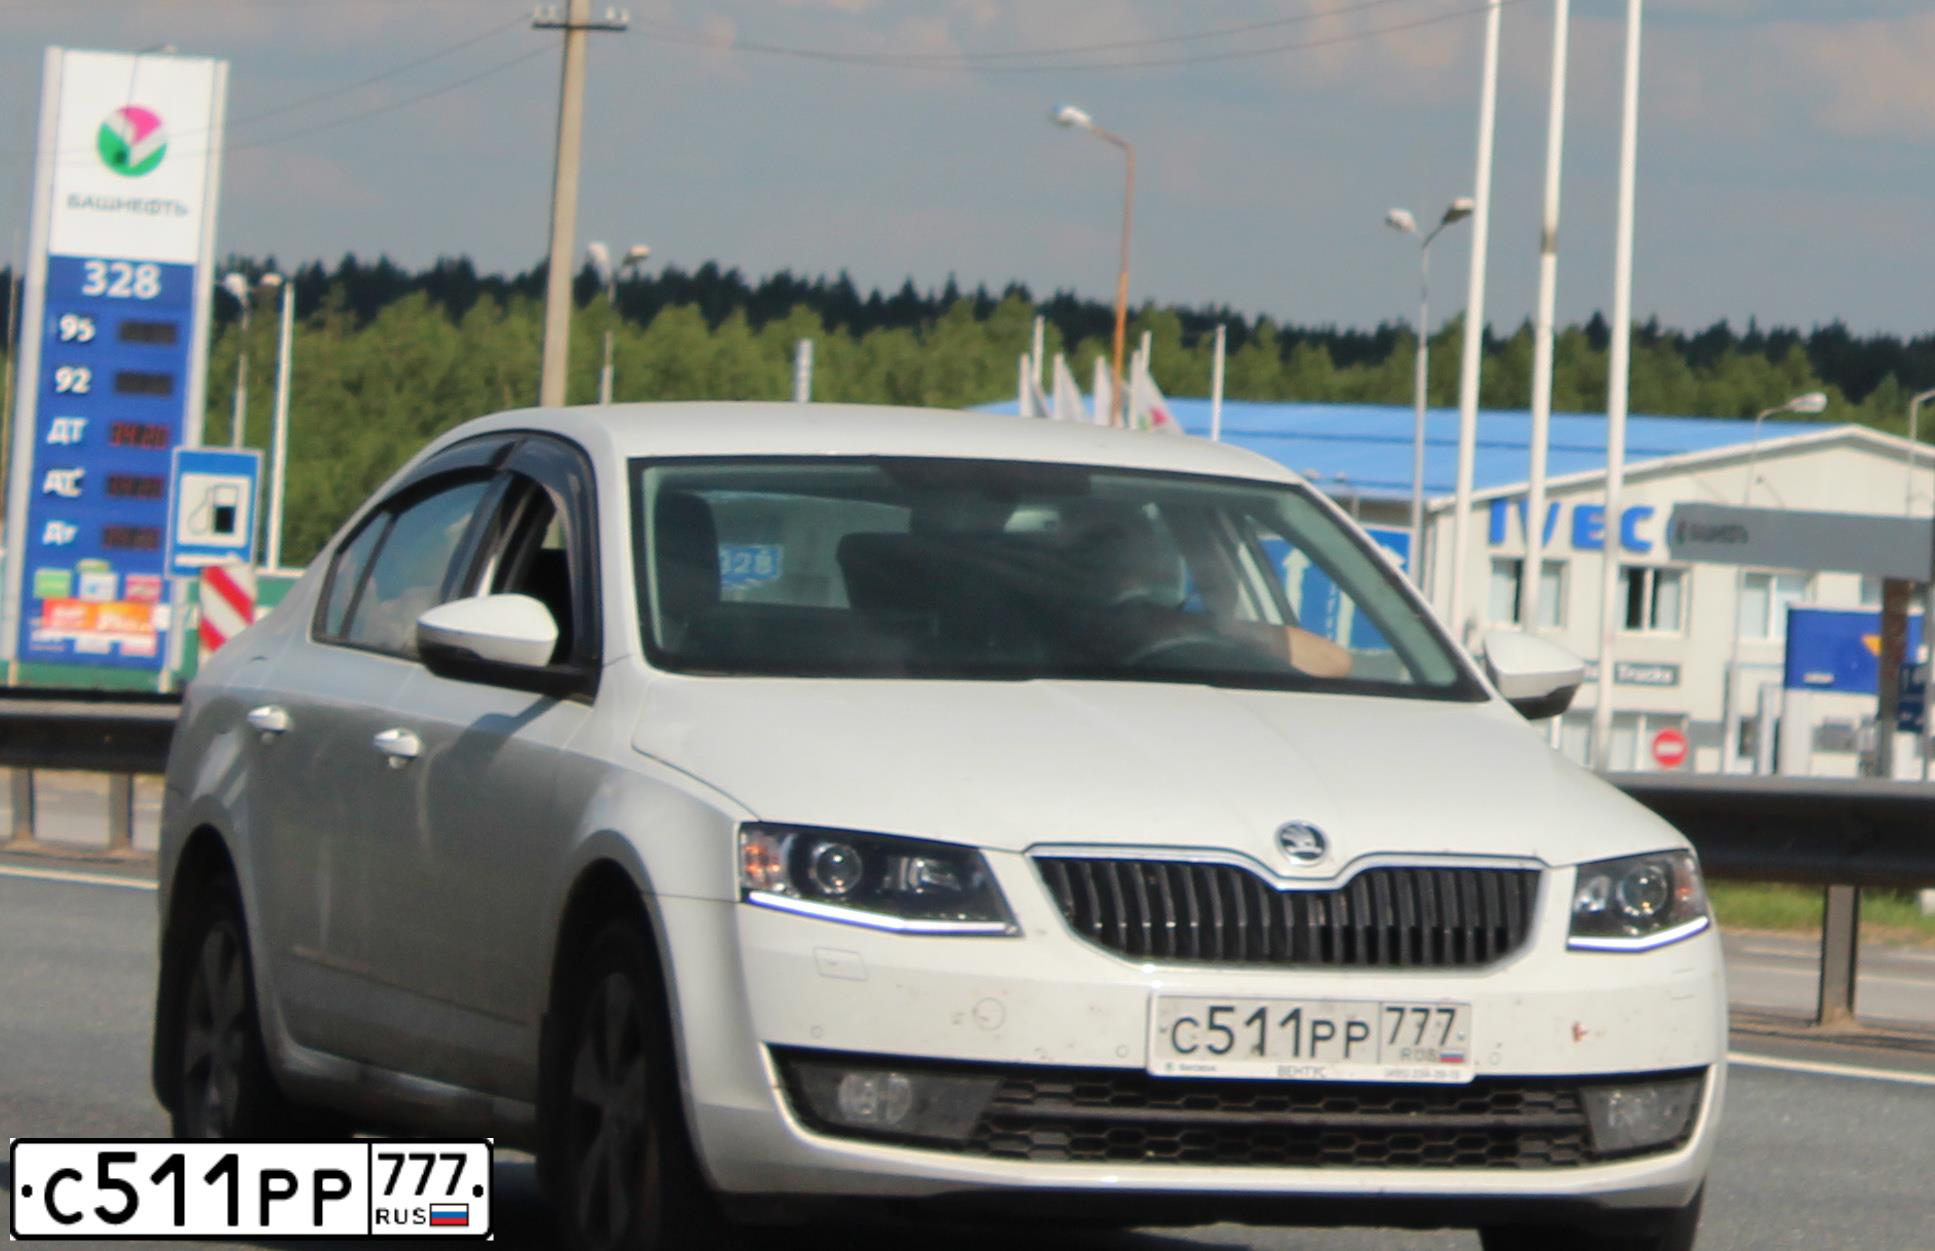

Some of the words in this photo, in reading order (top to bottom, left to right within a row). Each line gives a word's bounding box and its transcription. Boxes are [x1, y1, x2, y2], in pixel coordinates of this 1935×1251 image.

[67, 195, 189, 216] БАШНЕФТЬ
[82, 261, 161, 299] 328
[59, 313, 96, 342] 95
[54, 366, 92, 393] 92
[47, 417, 88, 445] ДТ
[1488, 498, 1677, 555] IVEC
[1384, 1007, 1456, 1046] 777
